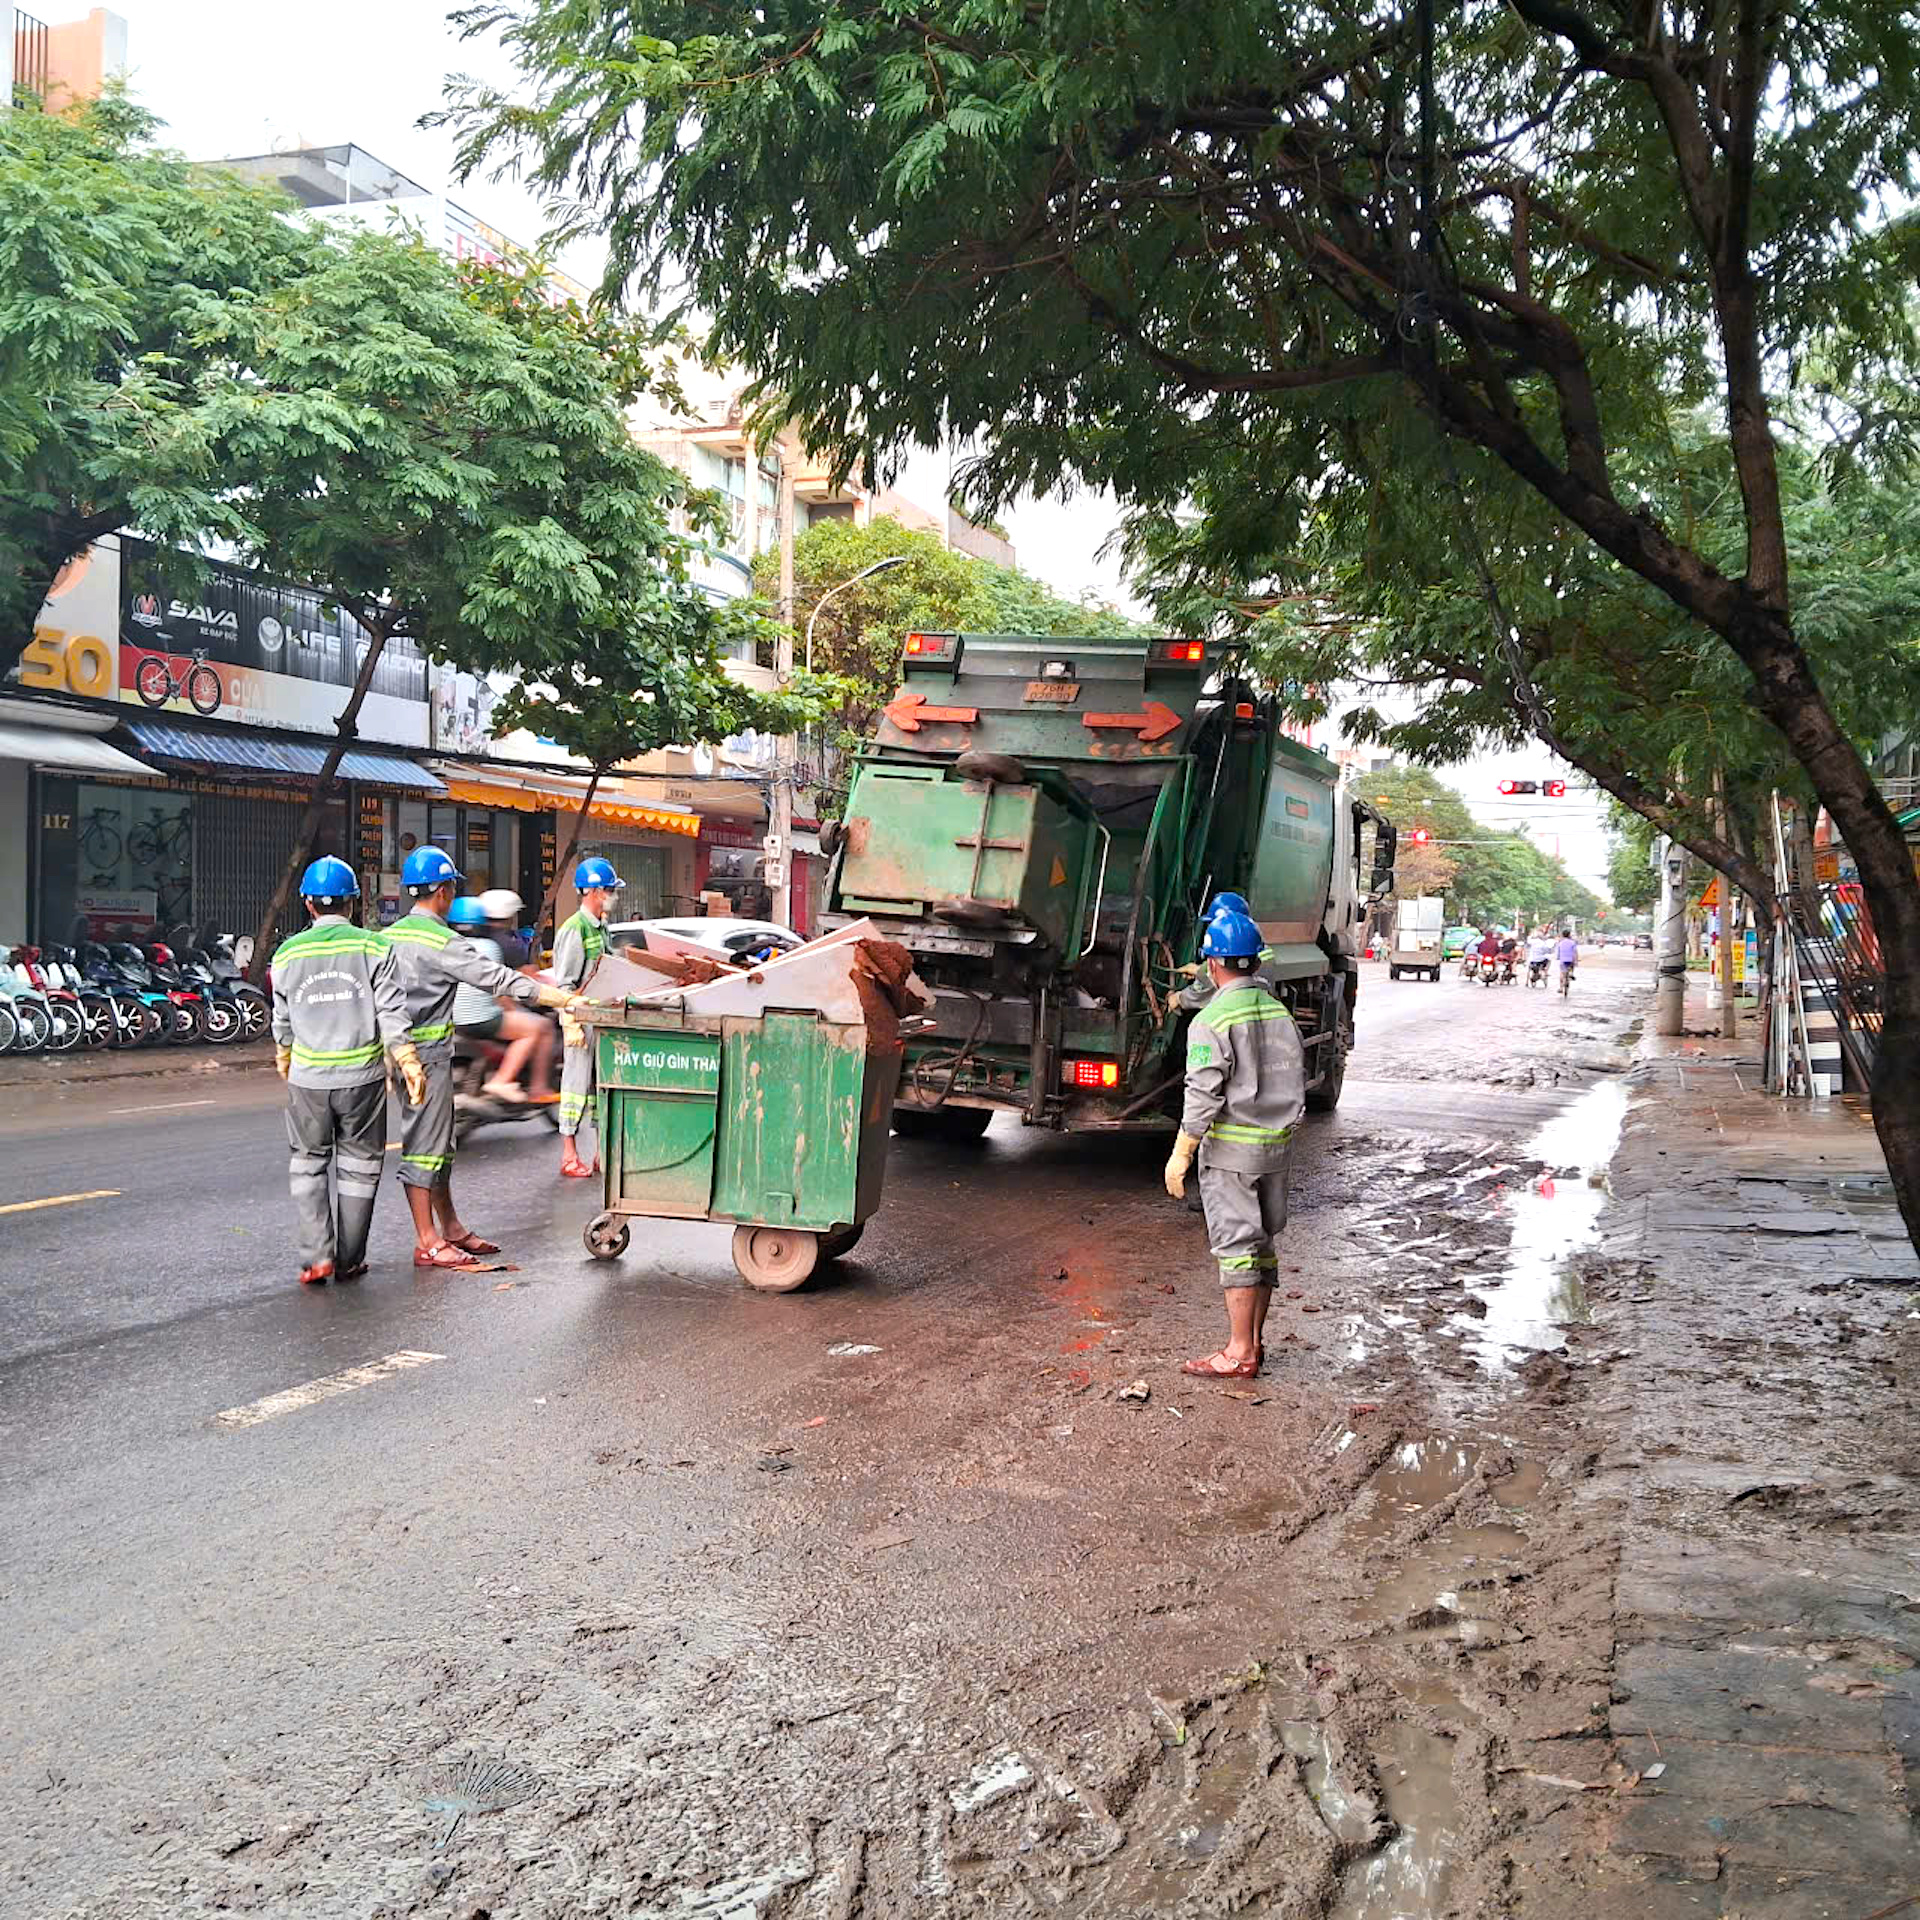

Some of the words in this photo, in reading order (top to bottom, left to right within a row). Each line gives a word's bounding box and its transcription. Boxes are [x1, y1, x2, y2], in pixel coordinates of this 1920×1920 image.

[167, 599, 239, 629] SAVA
[43, 814, 71, 829] 117
[667, 1053, 690, 1069] GÌN
